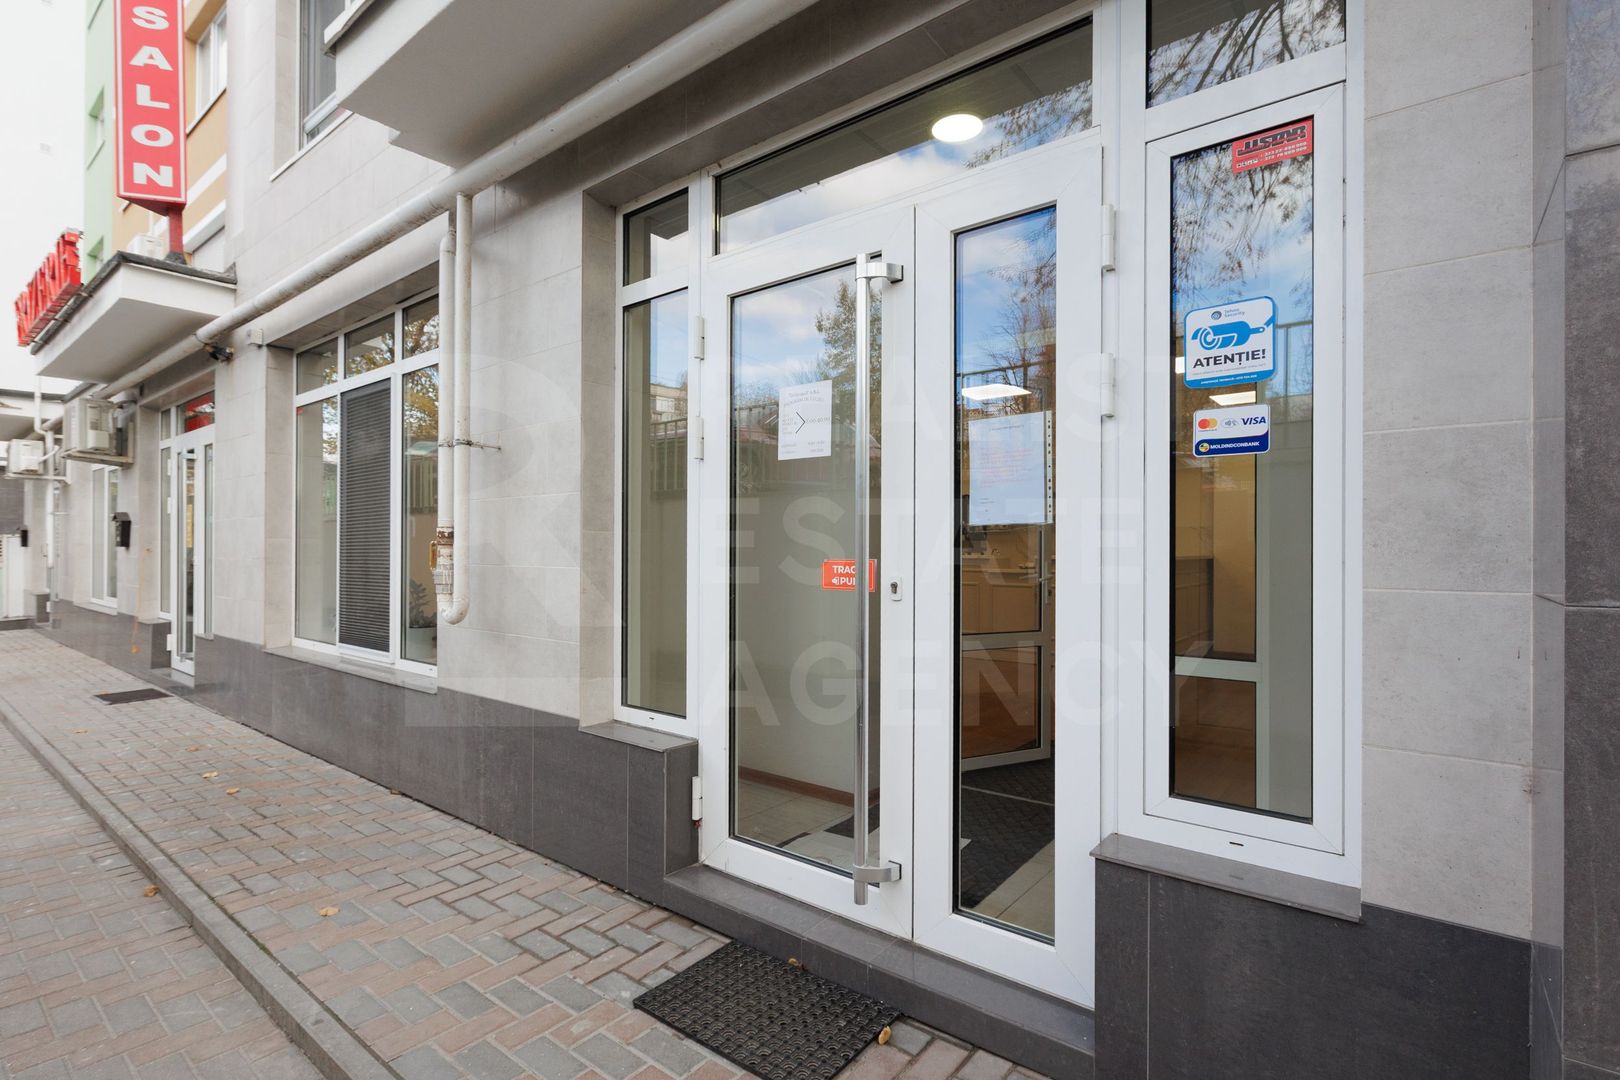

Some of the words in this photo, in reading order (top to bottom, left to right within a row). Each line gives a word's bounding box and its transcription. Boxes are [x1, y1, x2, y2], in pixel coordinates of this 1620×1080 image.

[129, 6, 175, 188] SALON
[1193, 348, 1266, 368] ATENȚIE!
[1242, 416, 1266, 426] VISA
[1210, 441, 1260, 450] MOLDINDCONBANK
